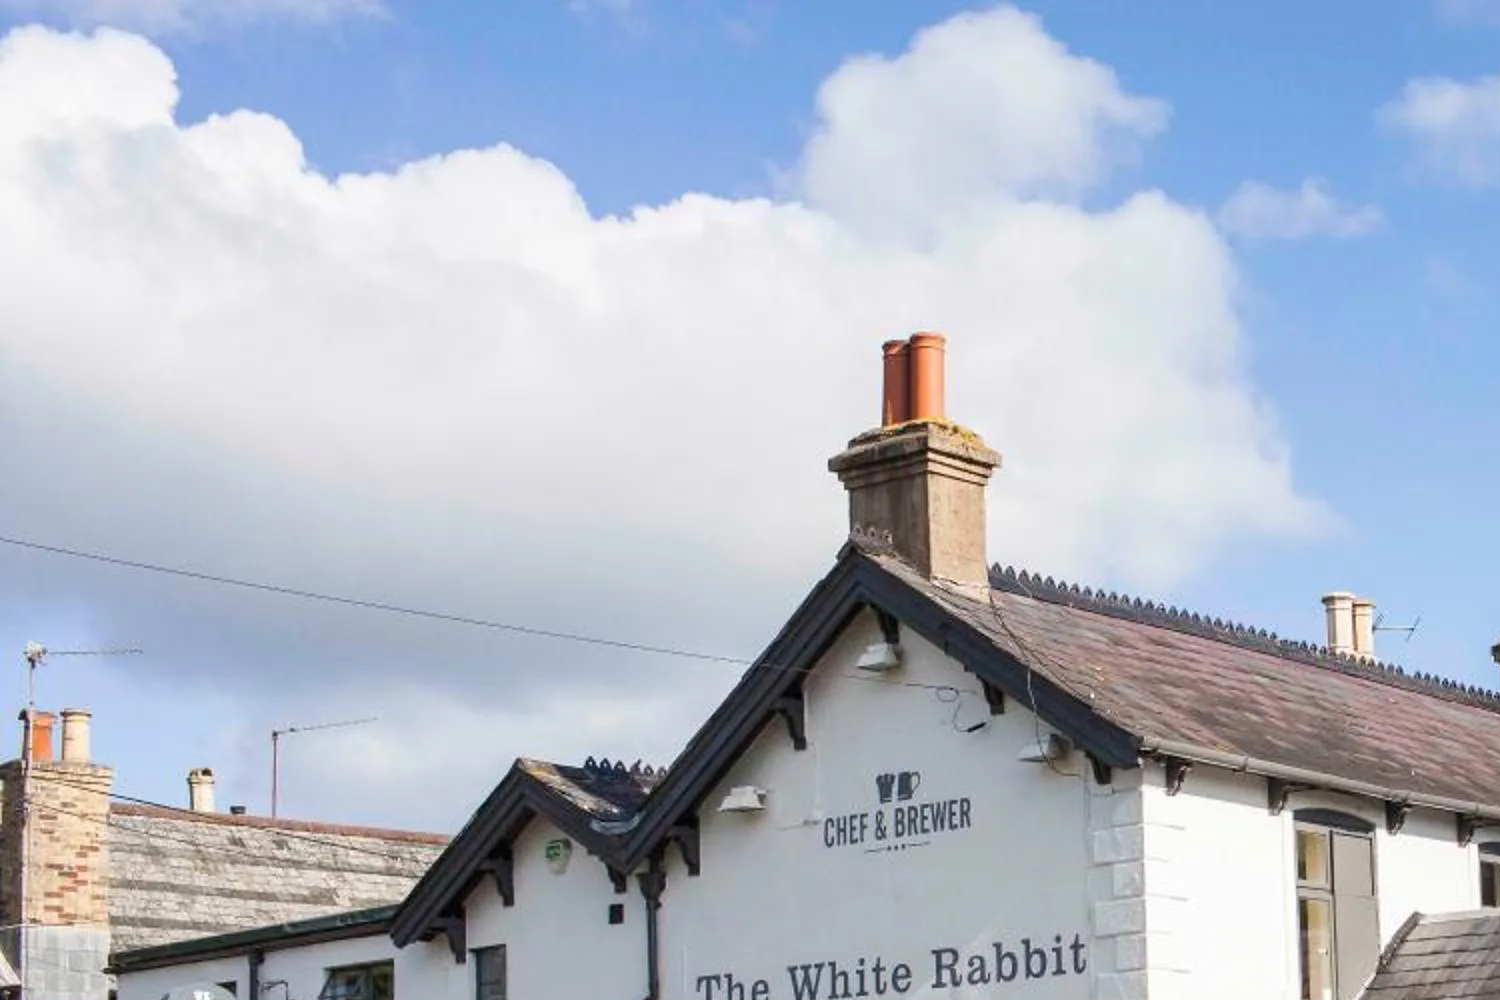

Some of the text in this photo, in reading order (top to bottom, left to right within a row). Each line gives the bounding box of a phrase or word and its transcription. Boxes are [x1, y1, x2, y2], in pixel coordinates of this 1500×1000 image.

[823, 797, 971, 848] CHEF & BREWER
[931, 932, 1087, 989] Rabbit
